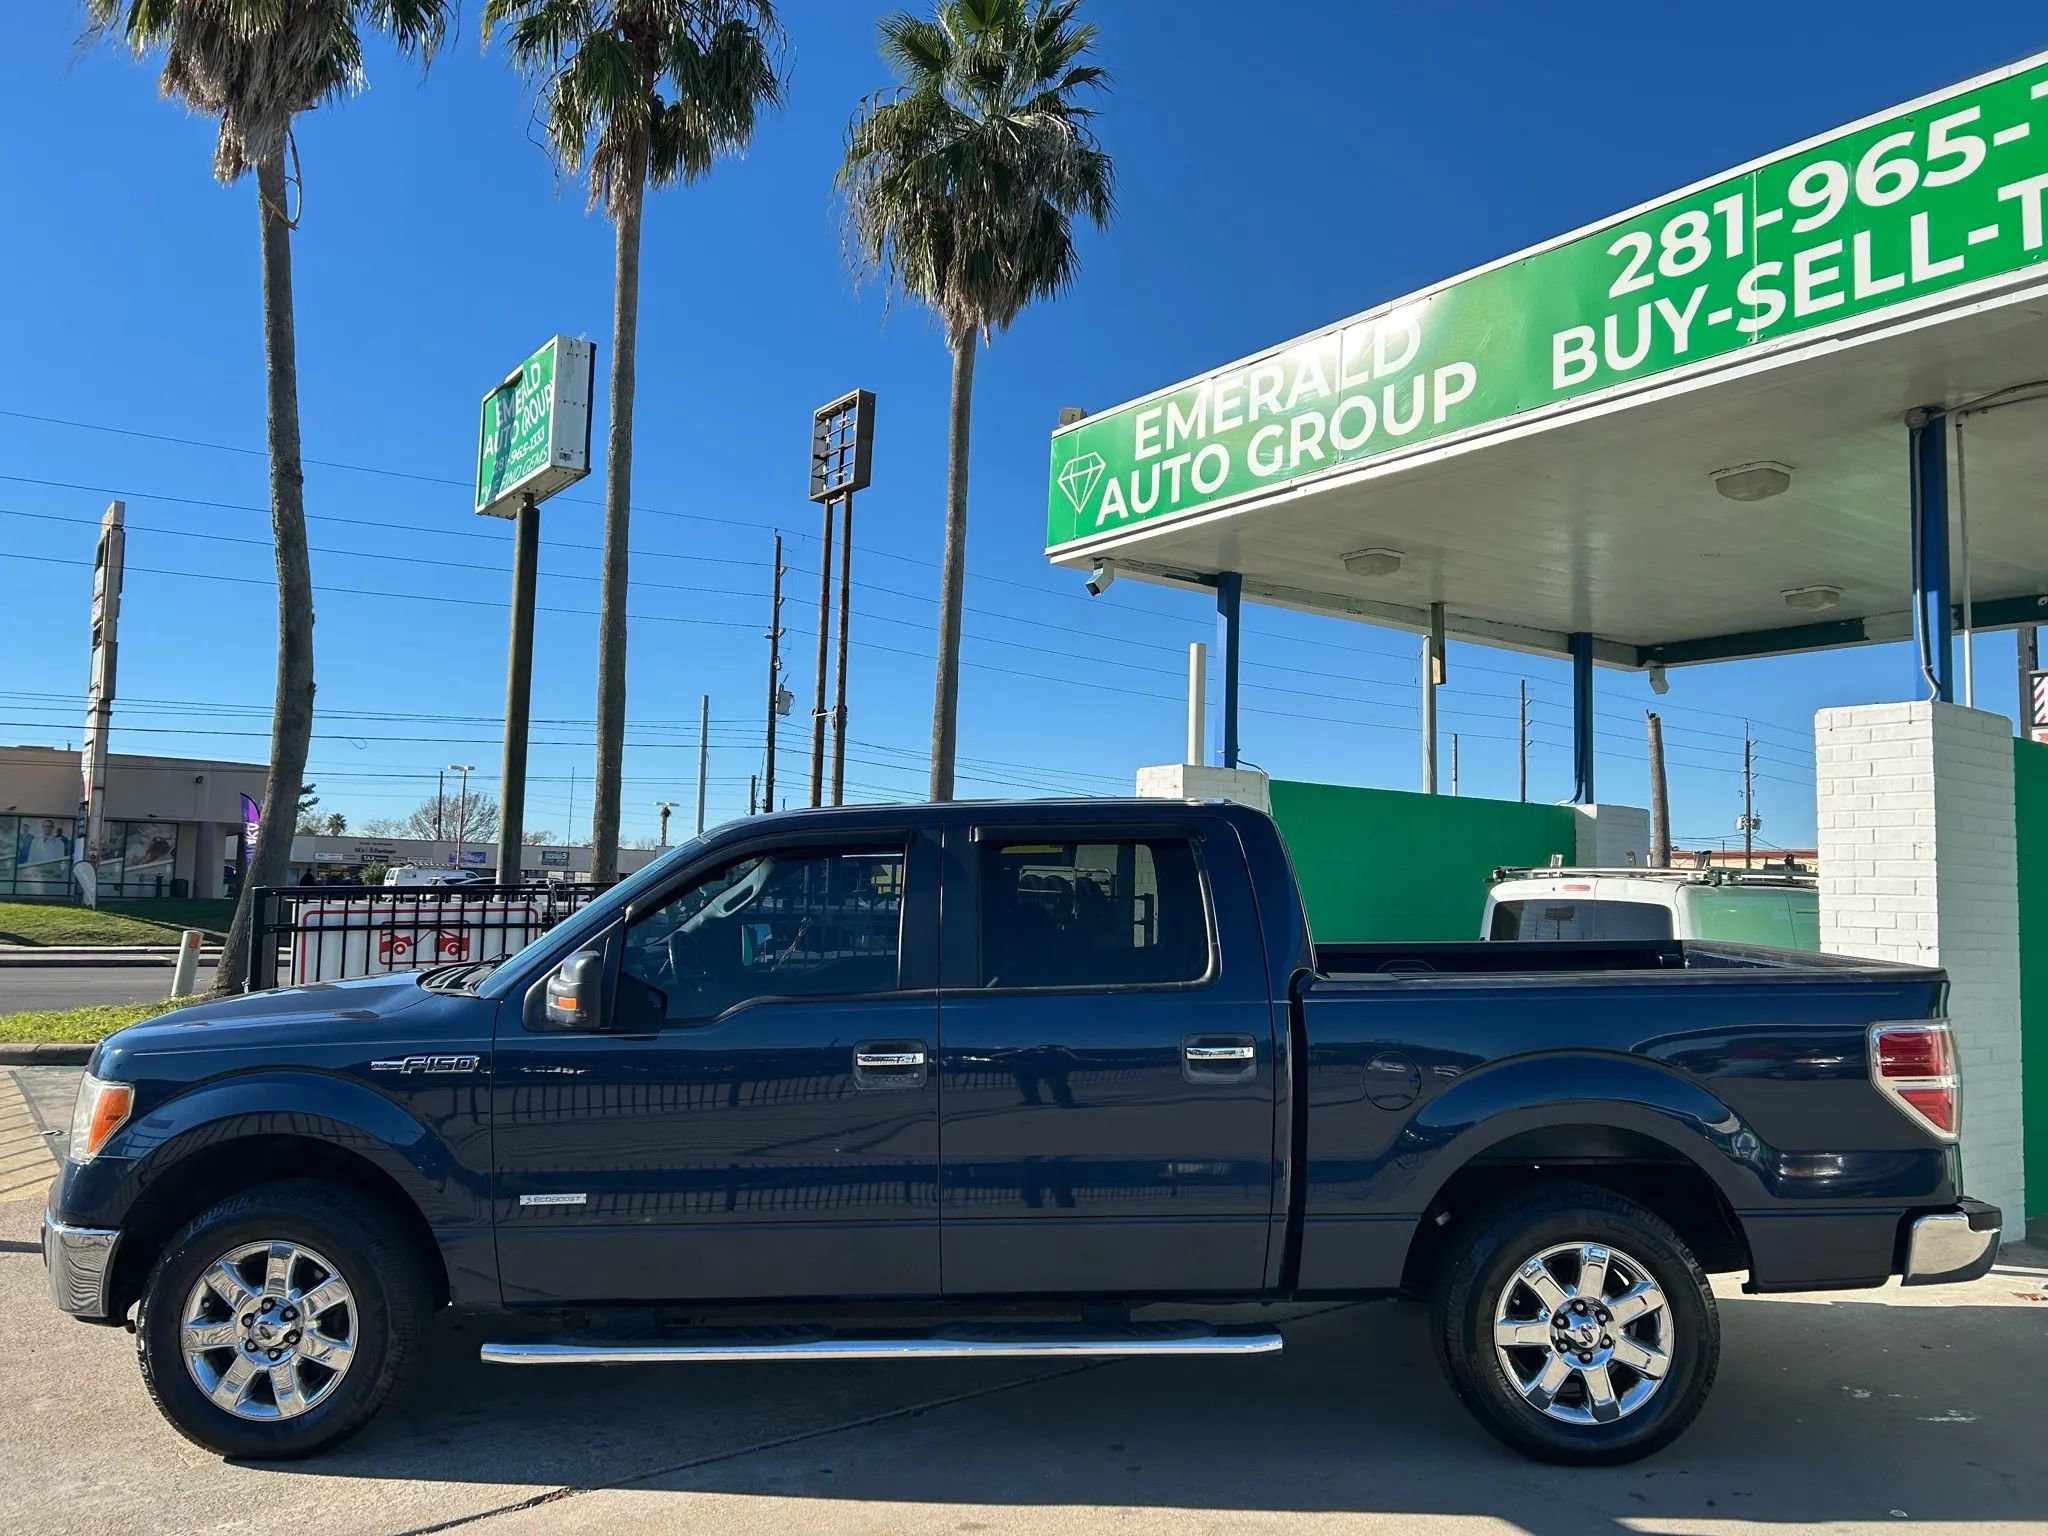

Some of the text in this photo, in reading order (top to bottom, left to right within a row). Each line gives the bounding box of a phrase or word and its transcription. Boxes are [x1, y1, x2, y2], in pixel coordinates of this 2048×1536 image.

[1095, 361, 1477, 527] AUTO GROUP
[1135, 317, 1421, 462] EMERALD
